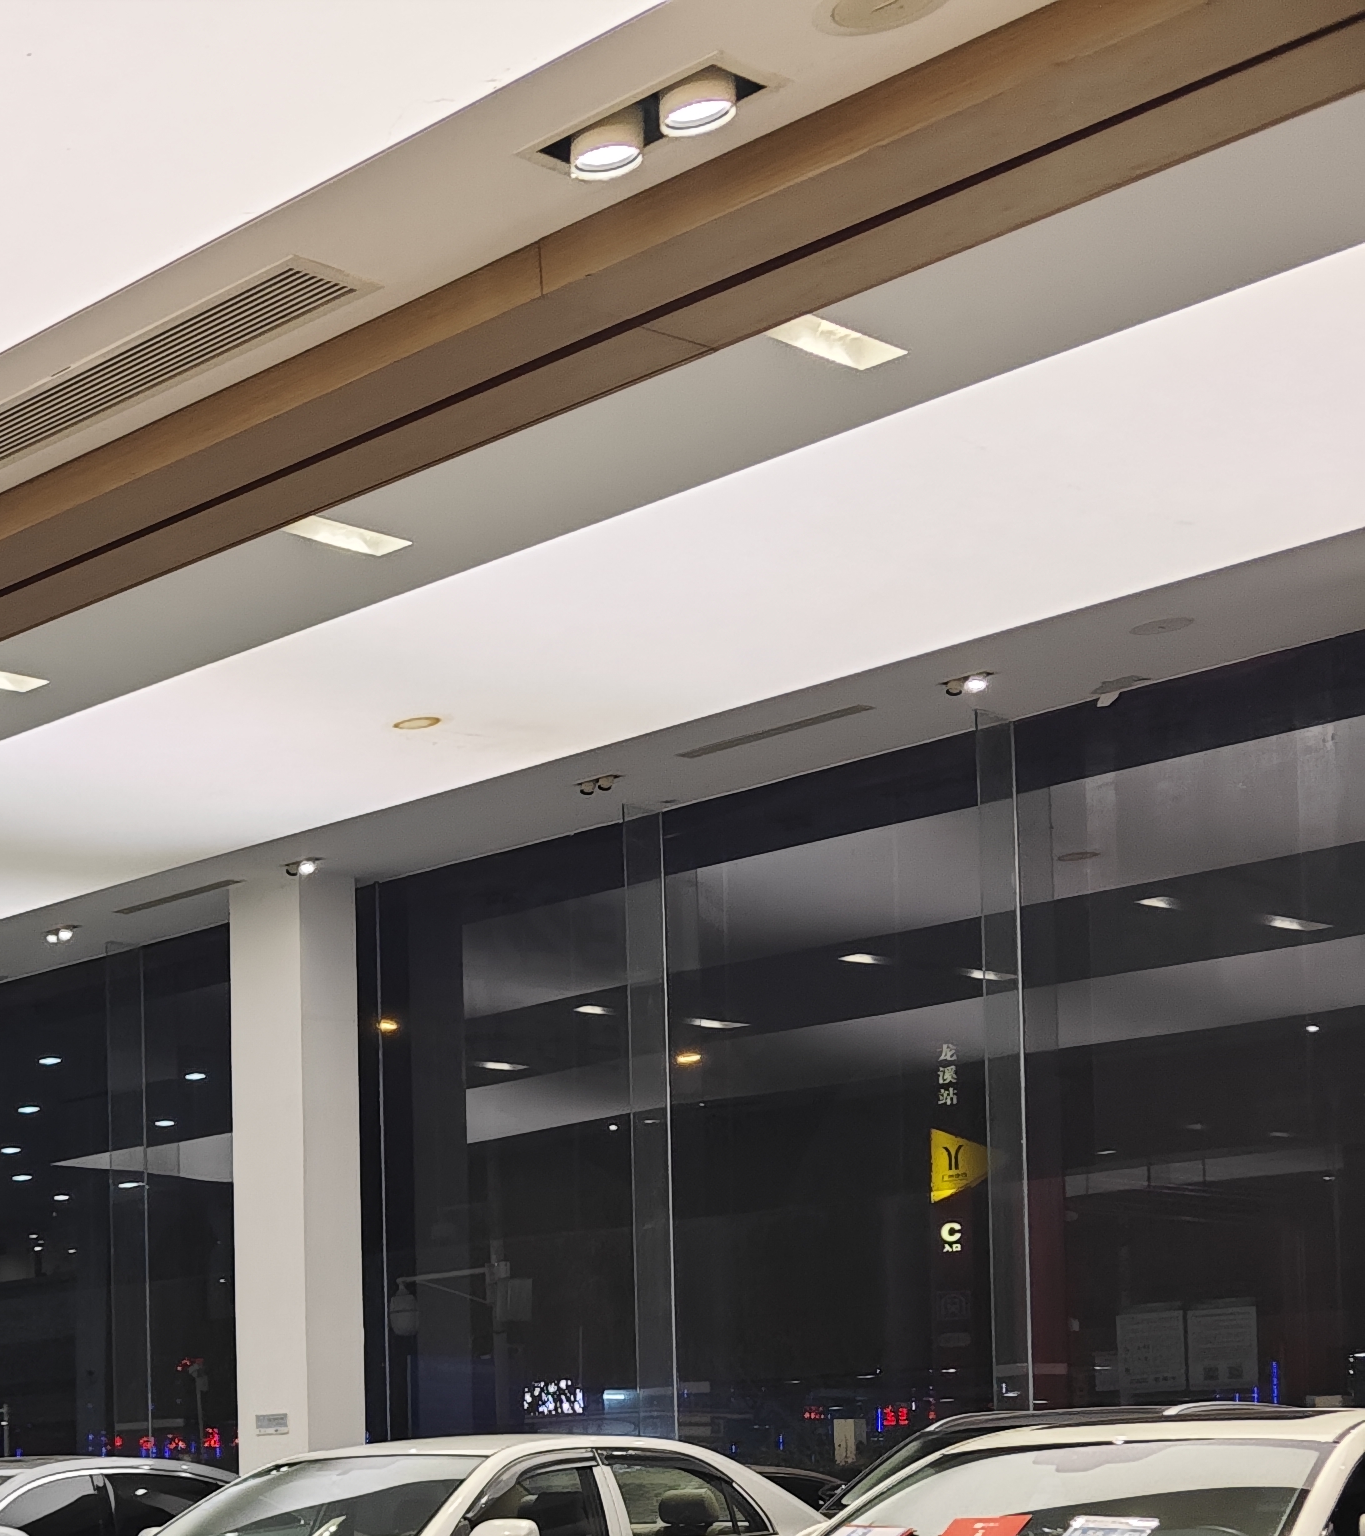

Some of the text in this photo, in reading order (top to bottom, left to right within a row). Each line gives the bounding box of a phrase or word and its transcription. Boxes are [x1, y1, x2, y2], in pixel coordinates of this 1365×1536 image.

[937, 1043, 957, 1106] 龙溪站
[940, 1221, 962, 1242] C
[943, 1243, 961, 1252] 入口
